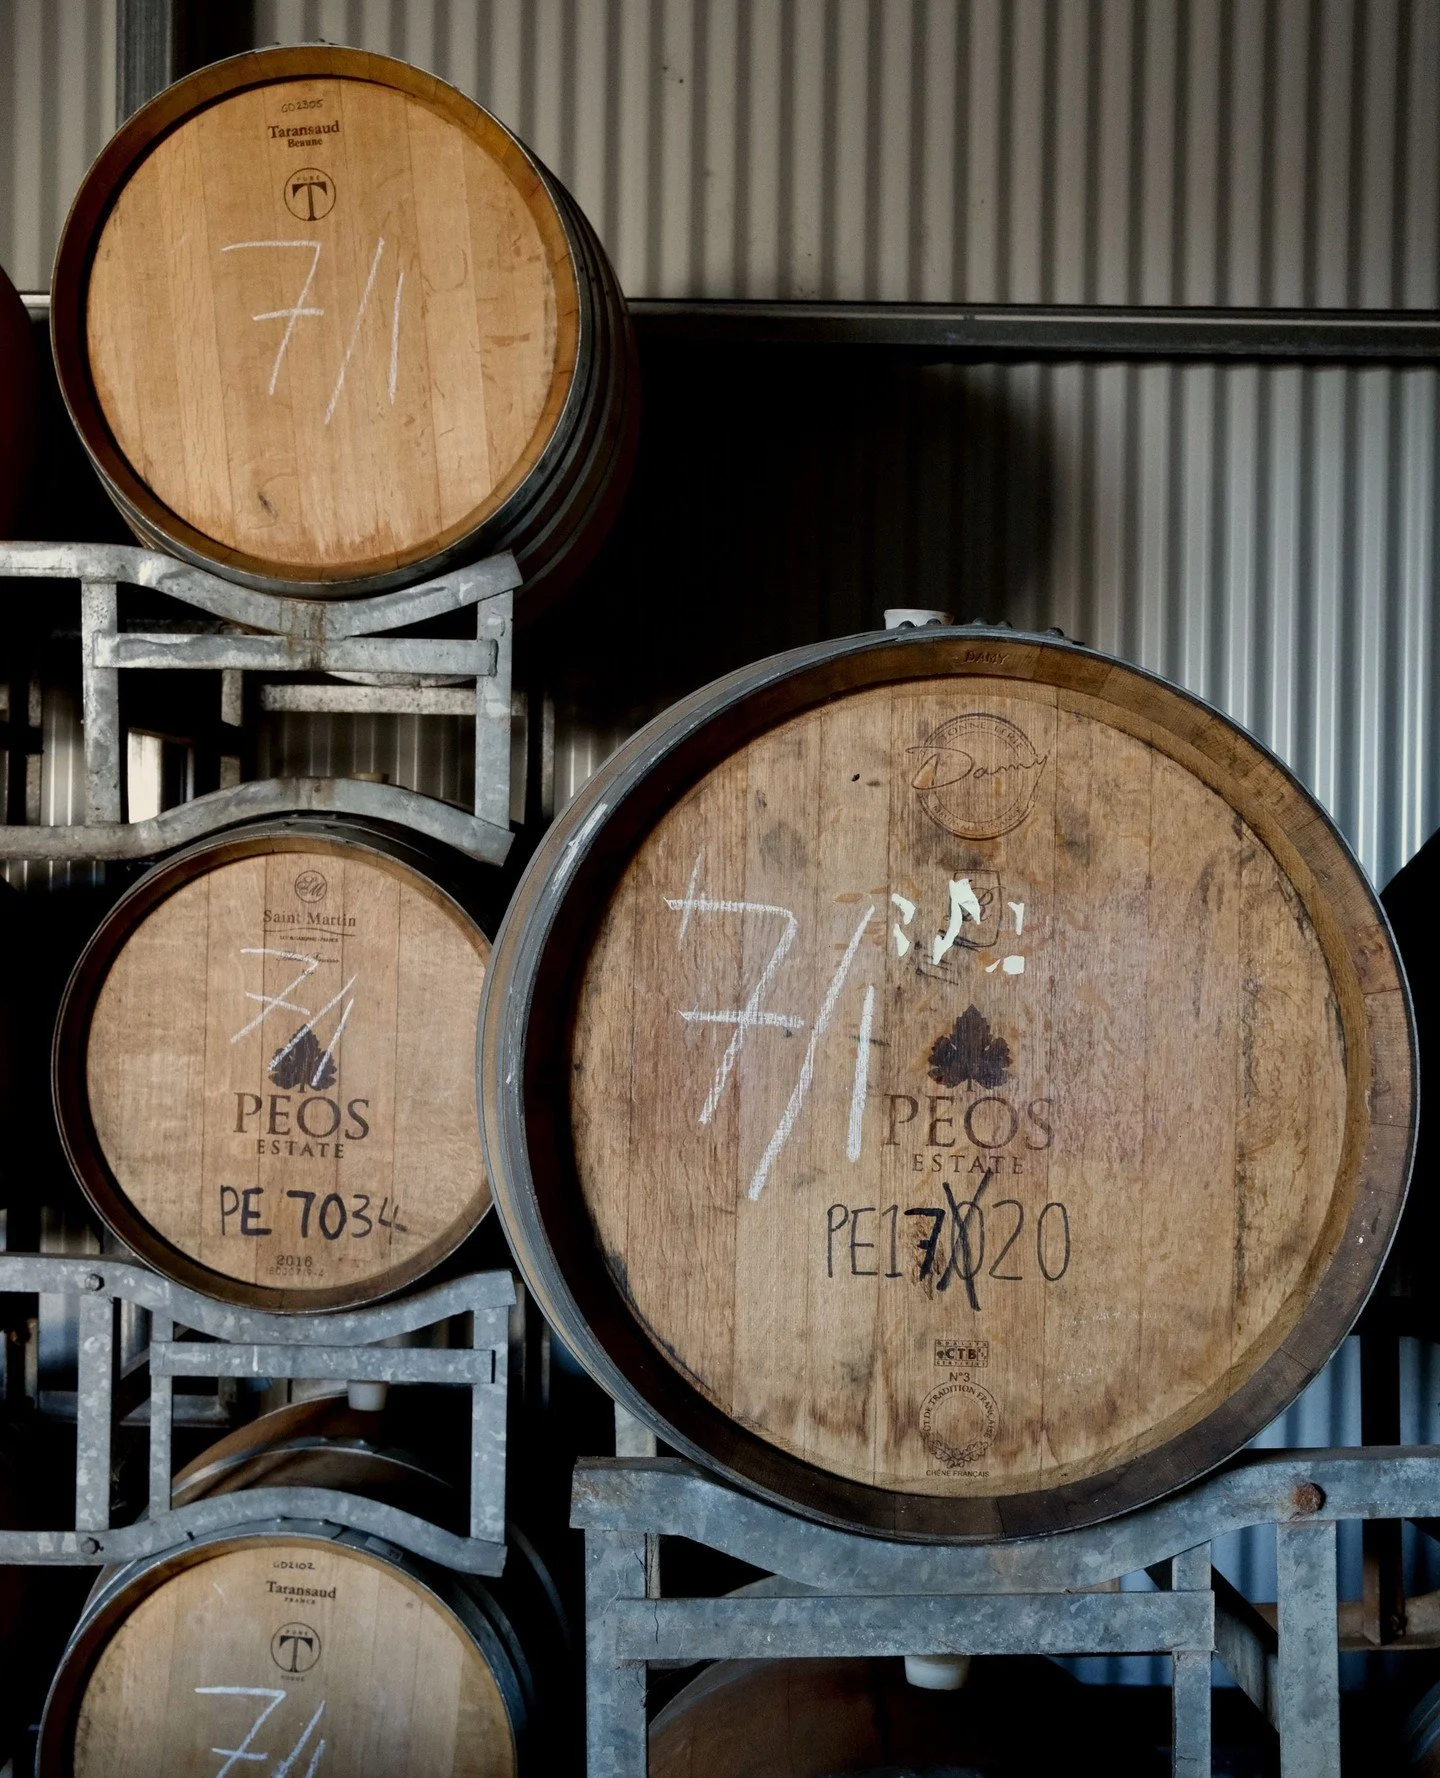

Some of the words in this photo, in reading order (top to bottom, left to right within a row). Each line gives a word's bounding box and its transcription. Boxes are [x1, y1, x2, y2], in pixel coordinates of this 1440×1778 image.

[267, 120, 340, 138] Taransaud
[288, 139, 323, 148] Beaune
[905, 745, 1048, 800] Damy
[264, 909, 300, 924] Saint
[307, 912, 356, 927] Martin
[233, 1092, 370, 1140] PEOS
[883, 1093, 1055, 1151] PEOS
[257, 1139, 344, 1158] ESTATE
[913, 1153, 1024, 1175] ESTATE
[220, 1185, 272, 1236] PE
[287, 1190, 407, 1245] 7034
[276, 1254, 313, 1268] 2016
[946, 1348, 977, 1360] CTB
[928, 1385, 976, 1406] TRADITION
[953, 1469, 989, 1478] FRANÇAIS
[266, 1580, 336, 1599] Taransaud
